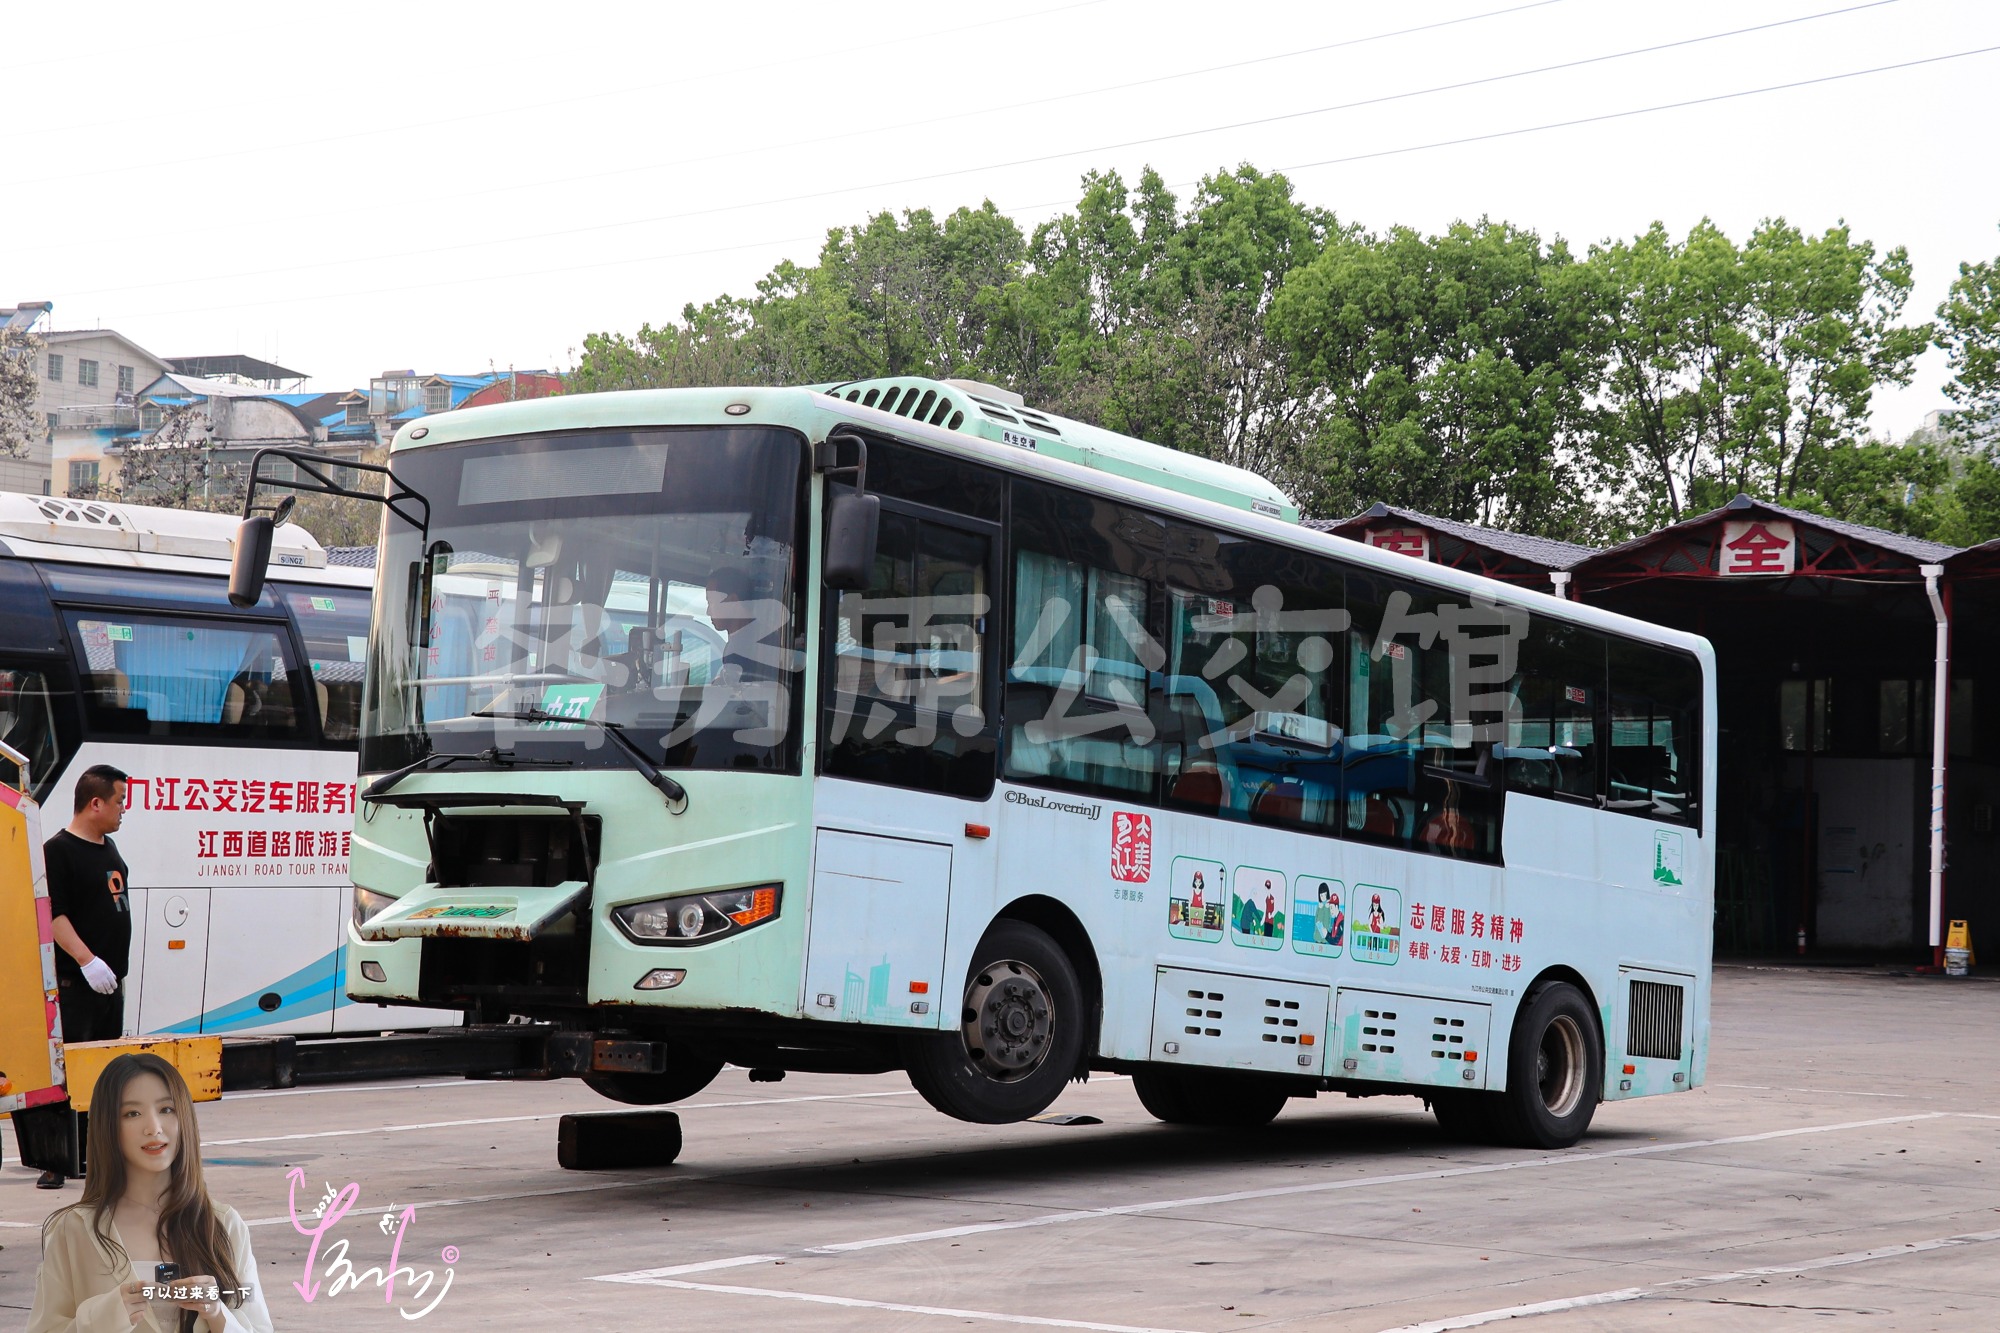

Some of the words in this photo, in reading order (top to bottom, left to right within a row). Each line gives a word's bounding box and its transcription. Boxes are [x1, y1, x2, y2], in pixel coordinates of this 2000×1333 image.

[1727, 523, 1790, 573] 全
[280, 556, 303, 565] SONGZ
[198, 864, 248, 877] JIANGXI
[254, 864, 283, 876] ROAD
[288, 863, 316, 875] TOUR
[1114, 888, 1144, 903] 志愿服务
[1410, 902, 1523, 943] 志愿服务精神
